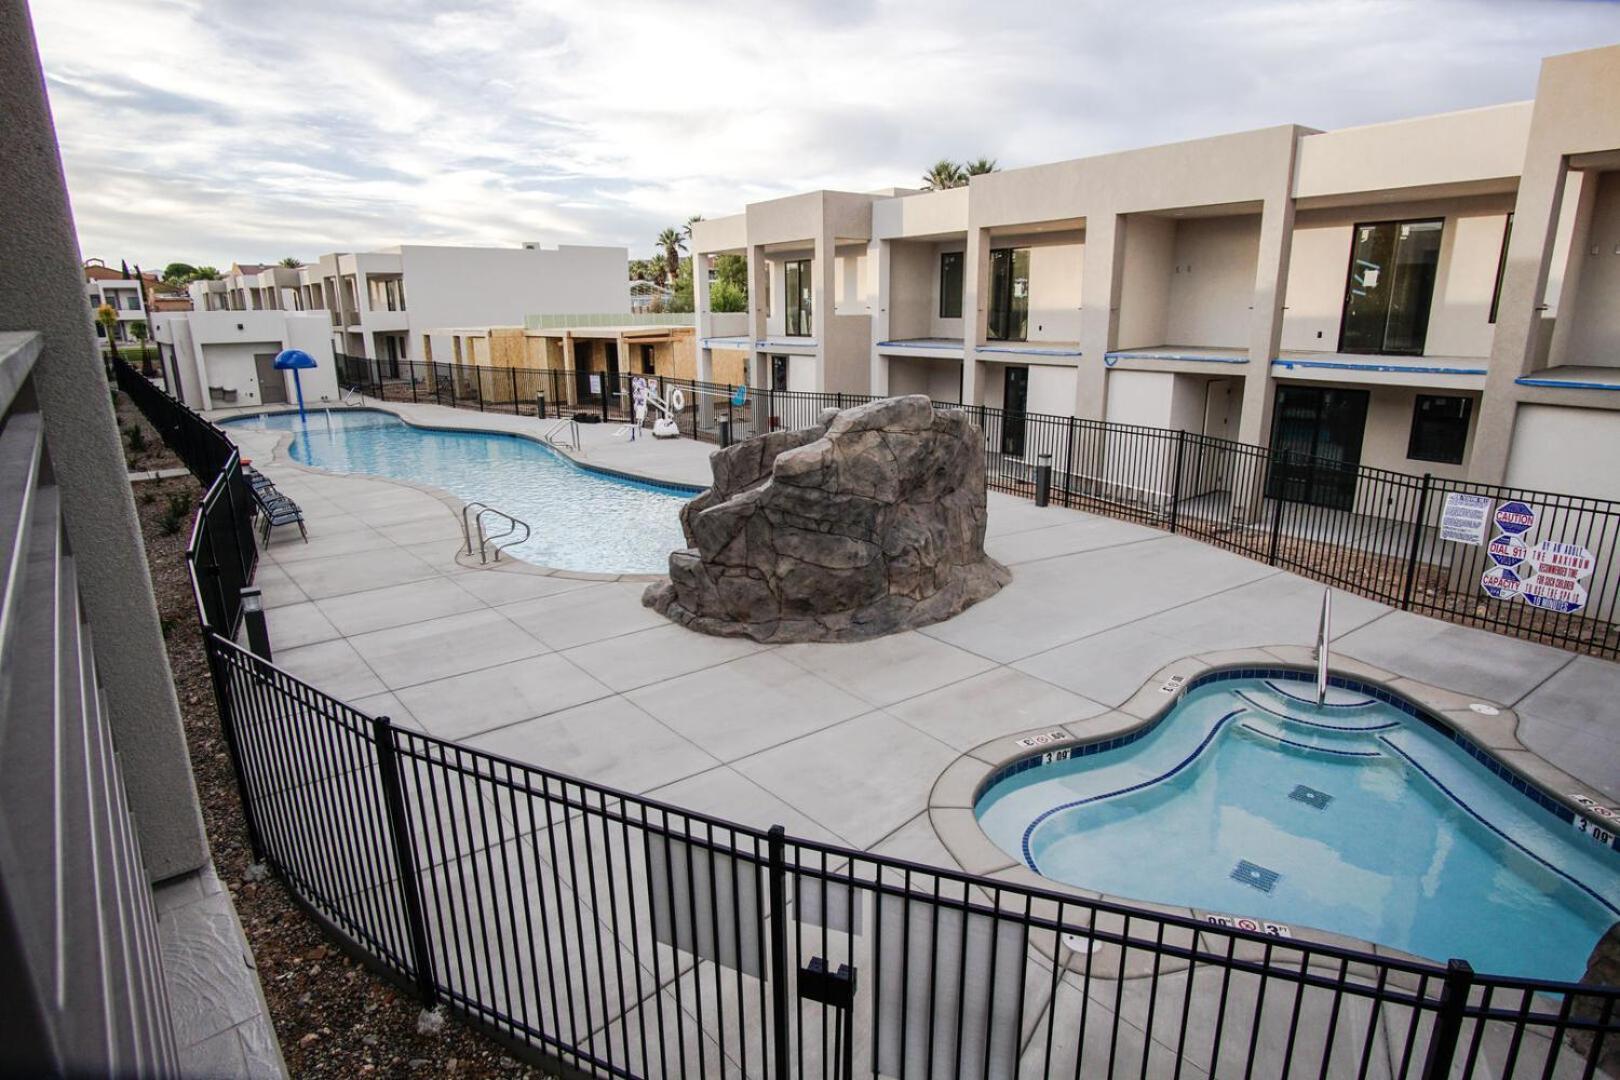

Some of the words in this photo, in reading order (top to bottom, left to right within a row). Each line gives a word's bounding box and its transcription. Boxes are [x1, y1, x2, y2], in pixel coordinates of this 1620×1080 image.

[1496, 511, 1533, 525] CAUTION
[1490, 543, 1509, 555] DIAL
[1512, 547, 1527, 558] 911
[1532, 550, 1546, 562] THE
[1552, 554, 1590, 569] MAXIMUM
[1483, 576, 1520, 591] CAPACITY
[1547, 587, 1558, 598] THE
